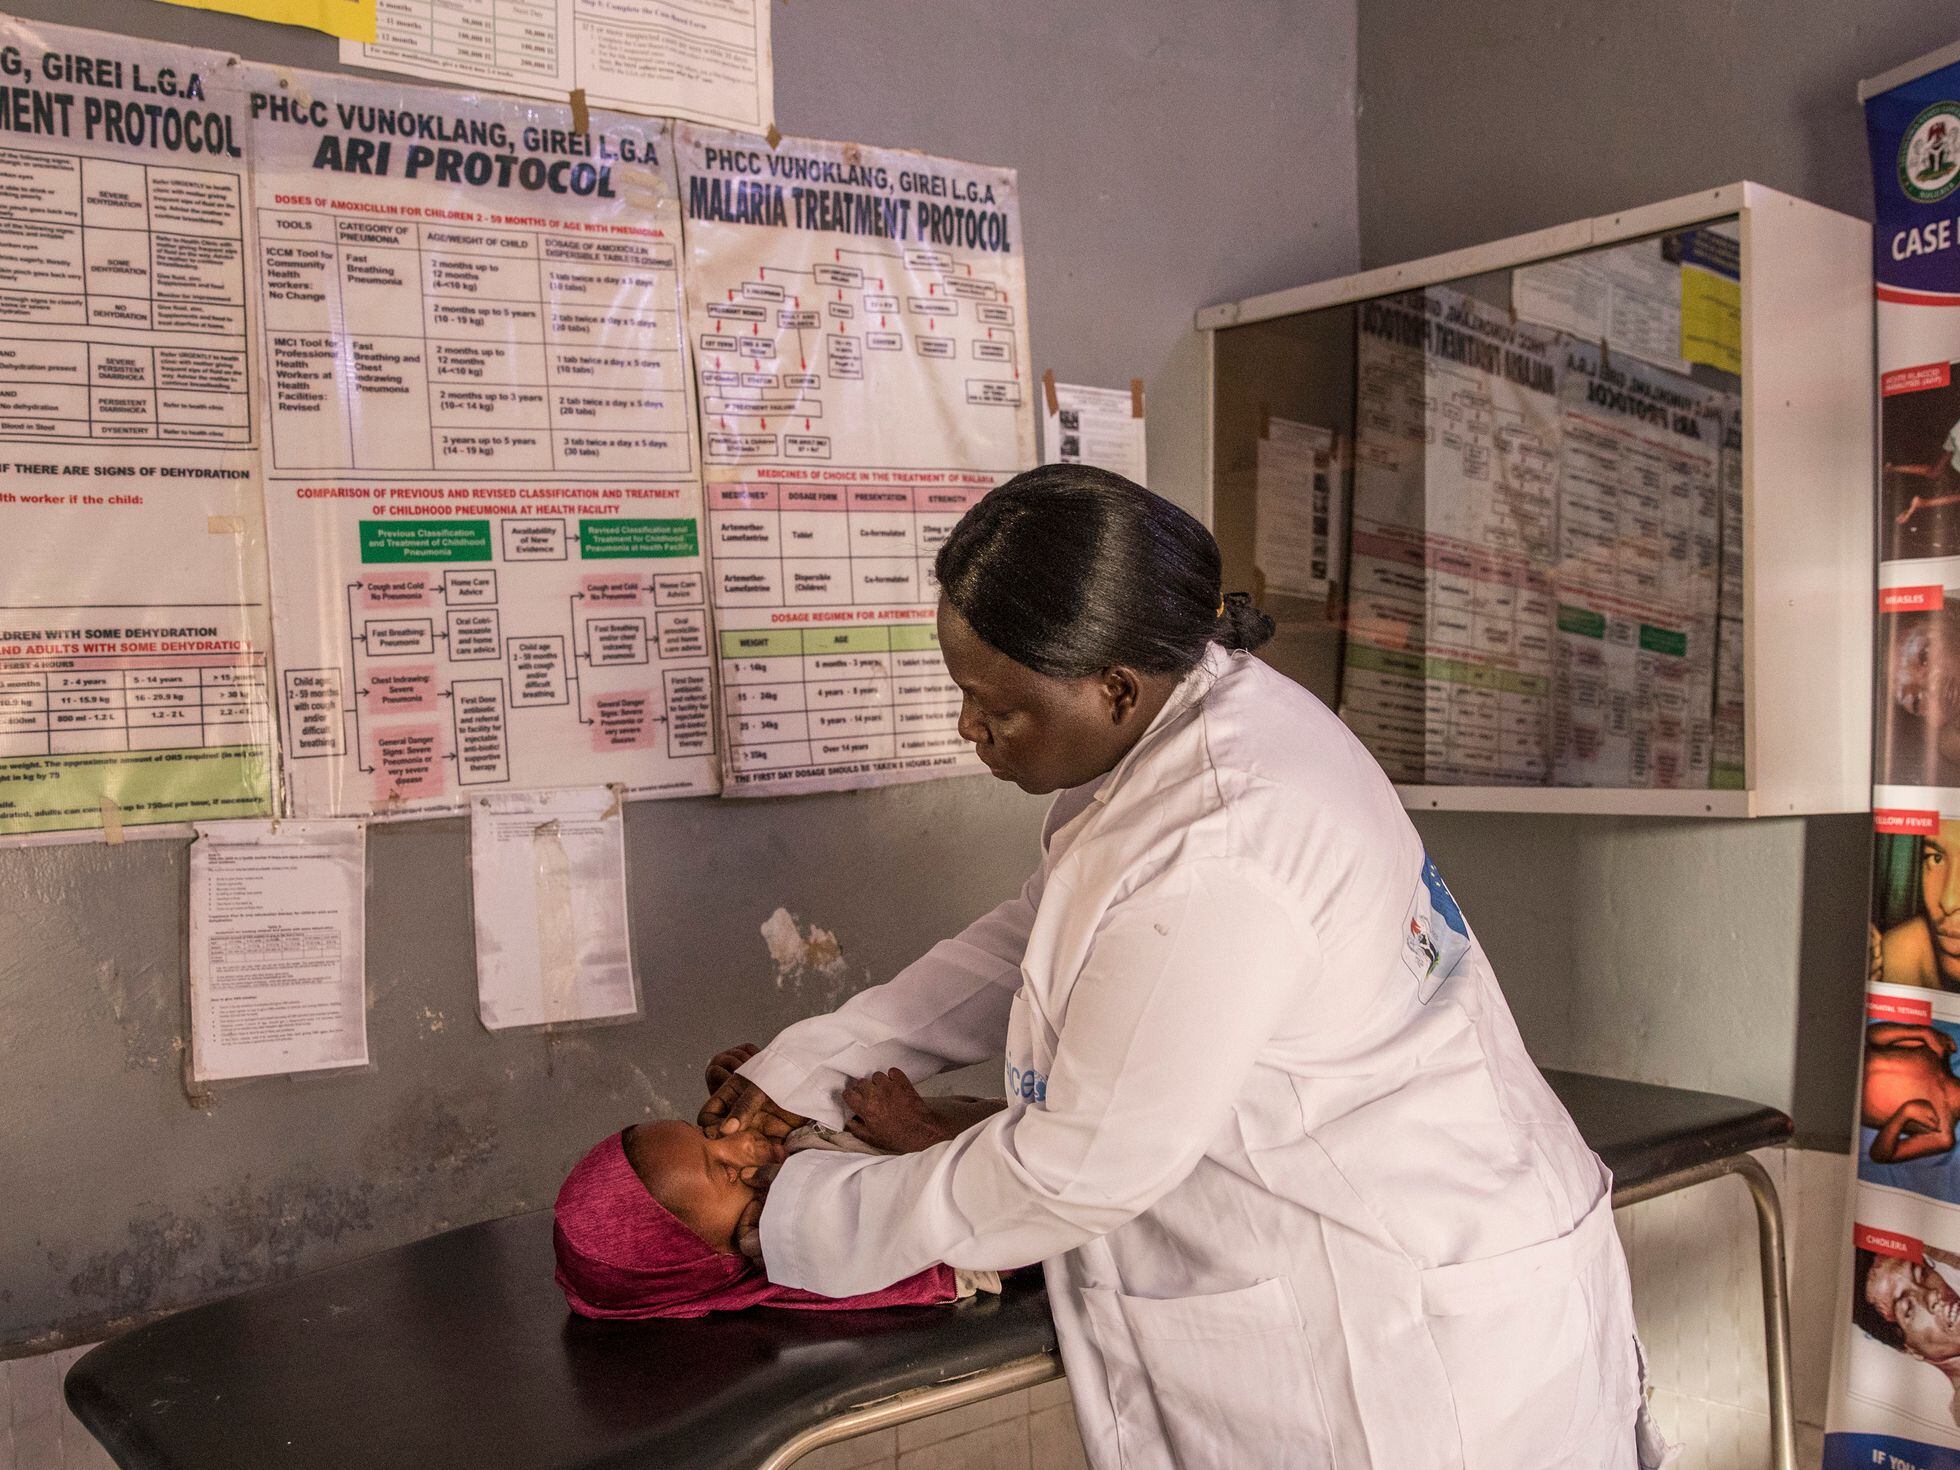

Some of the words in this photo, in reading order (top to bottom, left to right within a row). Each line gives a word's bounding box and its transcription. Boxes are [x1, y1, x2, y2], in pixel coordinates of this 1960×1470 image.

[42, 52, 122, 89] GIREI
[133, 64, 205, 101] L.G.A
[85, 97, 241, 158] PROTOCOL
[251, 93, 328, 128] PHCC
[336, 103, 515, 154] VUNOKLANG,
[523, 126, 592, 157] GIREI
[600, 135, 659, 167] L.G.A
[312, 135, 391, 176] ARI
[405, 144, 616, 199] PROTOCOL
[705, 147, 761, 175] PHCC
[767, 154, 894, 196] VUNOKLANG,
[899, 171, 947, 198] GIREI
[953, 179, 996, 205] L.G.A
[275, 194, 312, 206] DOSES
[315, 197, 328, 207] OF
[330, 200, 398, 215] AMOXICILLIN
[401, 205, 422, 216] FOR
[425, 208, 474, 221] CHILDREN
[505, 215, 547, 227] MONTHS
[549, 220, 561, 228] OF
[563, 221, 581, 231] AGE
[584, 223, 609, 233] WITH
[690, 175, 787, 228] MALARIA
[792, 186, 911, 241] TREATMENT
[918, 200, 1010, 253] PROTOCOL
[276, 219, 312, 230] TOOLS
[339, 221, 393, 234] CATEGORY
[395, 226, 409, 235] OF
[340, 232, 400, 245] PNEUMONIA
[427, 232, 483, 246] AGE/WEIGHT
[486, 238, 497, 246] OF
[500, 239, 529, 249] CHILD
[1891, 218, 1951, 261] CASE
[266, 247, 293, 257] ICCM
[297, 249, 318, 258] Tool
[321, 250, 333, 260] for
[346, 253, 367, 263] Fast
[267, 258, 325, 271] Community
[347, 264, 394, 276] Breathing
[268, 269, 301, 279] Health
[348, 274, 403, 286] Pneumonia
[270, 291, 284, 300] No
[286, 291, 326, 302] Change
[301, 338, 321, 348] Tool
[325, 340, 338, 348] for
[276, 360, 308, 370] Health
[276, 371, 319, 380] Workers
[322, 371, 332, 380] at
[277, 381, 310, 391] Health
[279, 403, 320, 412] Revised
[0, 463, 10, 473] IF
[15, 464, 58, 476] THERE
[63, 466, 89, 476] ARE
[94, 466, 135, 477] SIGNS
[140, 467, 157, 477] OF
[160, 467, 250, 479] DEHYDRATION
[757, 469, 808, 480] MEDICINES
[811, 470, 820, 480] OF
[823, 471, 857, 480] CHOICE
[860, 471, 868, 481] IN
[872, 472, 890, 481] THE
[892, 472, 945, 483] TREATMENT
[948, 473, 959, 483] OF
[20, 496, 64, 505] worker
[69, 494, 78, 505] if
[83, 495, 103, 505] the
[108, 494, 144, 505] child:
[296, 488, 371, 499] COMPARISON
[373, 488, 387, 499] OF
[390, 488, 444, 499] PREVIOUS
[447, 488, 470, 499] AND
[472, 488, 516, 499] REVISED
[519, 488, 599, 499] CLASSIFICATION
[602, 488, 622, 499] AND
[626, 488, 680, 499] TREATMENT
[372, 504, 387, 515] OF
[390, 504, 452, 516] CHILDHOOD
[455, 504, 517, 516] PNEUMONIA
[520, 504, 533, 515] AT
[536, 504, 575, 515] HEALTH
[578, 504, 620, 515] FACILITY
[377, 529, 415, 538] Previous
[417, 528, 475, 538] Classification
[512, 526, 557, 537] Availability
[368, 540, 385, 548] and
[388, 538, 429, 547] Treatment
[431, 538, 440, 547] of
[442, 537, 486, 547] Childhood
[520, 536, 530, 545] of
[533, 535, 549, 545] New
[404, 547, 453, 557] Pneumonia
[516, 545, 554, 554] Evidence
[771, 613, 809, 624] DOSAGE
[812, 612, 852, 623] REGIMEN
[856, 610, 875, 622] FOR
[46, 629, 81, 640] WITH
[85, 628, 121, 639] SOME
[125, 627, 218, 639] DEHYDRATION
[0, 645, 23, 655] ND
[26, 644, 79, 654] ADULTS
[83, 643, 117, 654] WITH
[120, 641, 157, 653] SOME
[1875, 815, 1904, 826] ELLOW
[1865, 1234, 1908, 1252] CHOLERA
[1872, 1448, 1886, 1465] IF
